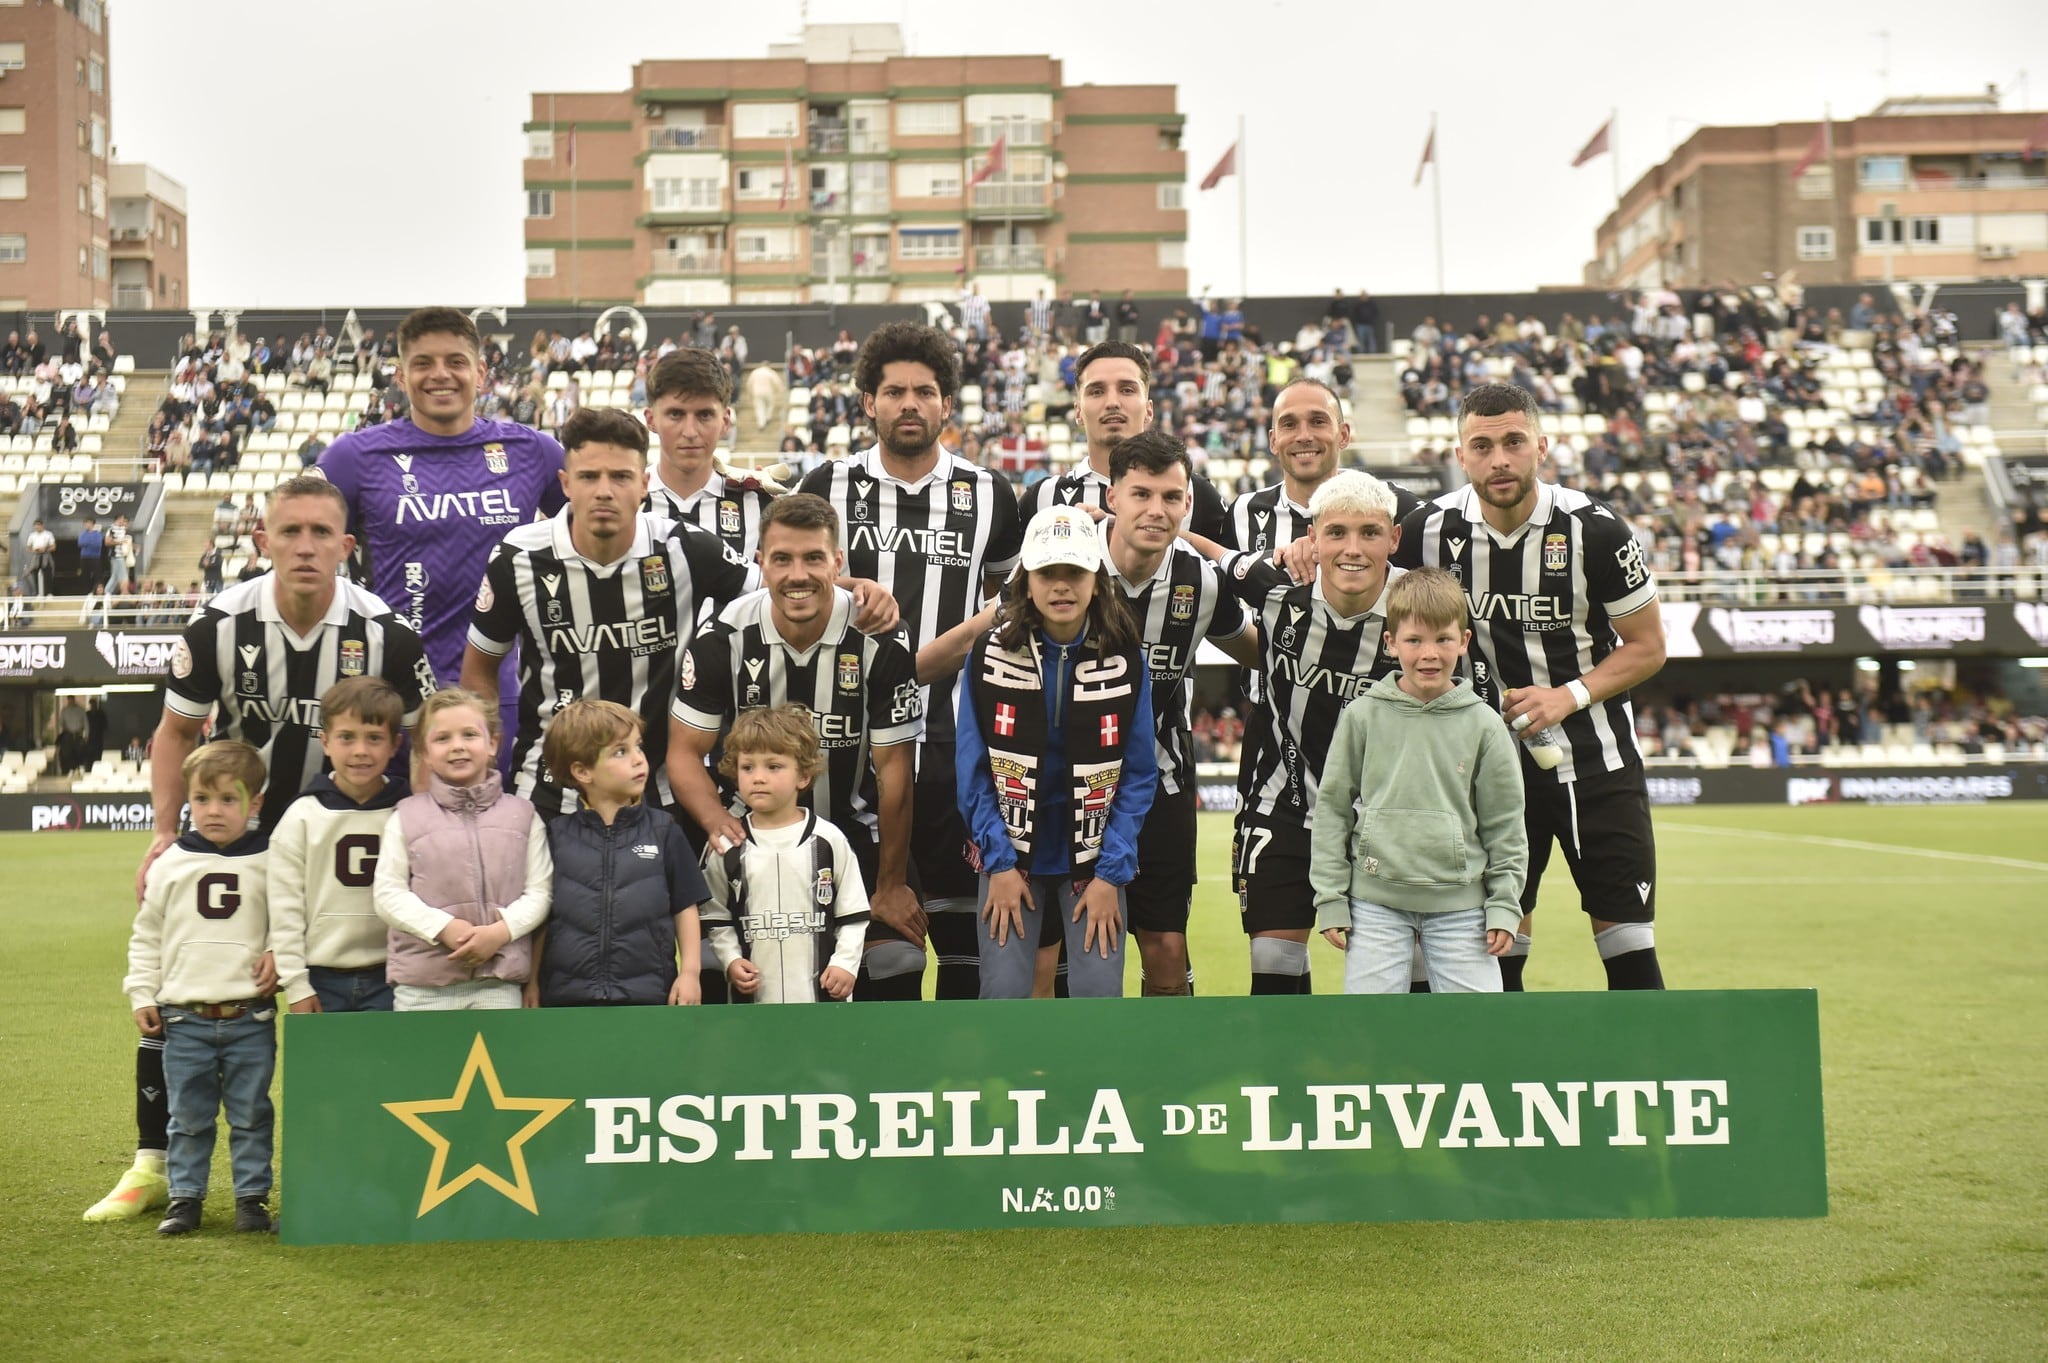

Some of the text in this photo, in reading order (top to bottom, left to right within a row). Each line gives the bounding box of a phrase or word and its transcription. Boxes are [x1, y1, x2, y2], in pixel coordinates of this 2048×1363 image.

[395, 489, 521, 525] AVATEL
[478, 514, 520, 526] TELECOM
[850, 525, 972, 557] AVATEL
[928, 555, 971, 568] TELECOM
[409, 593, 425, 634] INMO
[1523, 620, 1571, 632] TELECOM
[550, 615, 676, 655] AVATEL
[632, 638, 677, 657] TELECOM
[335, 834, 380, 887] G
[197, 873, 241, 919] G
[743, 927, 790, 943] group
[585, 1079, 1730, 1164] ESTRELLA DE LEVANTE
